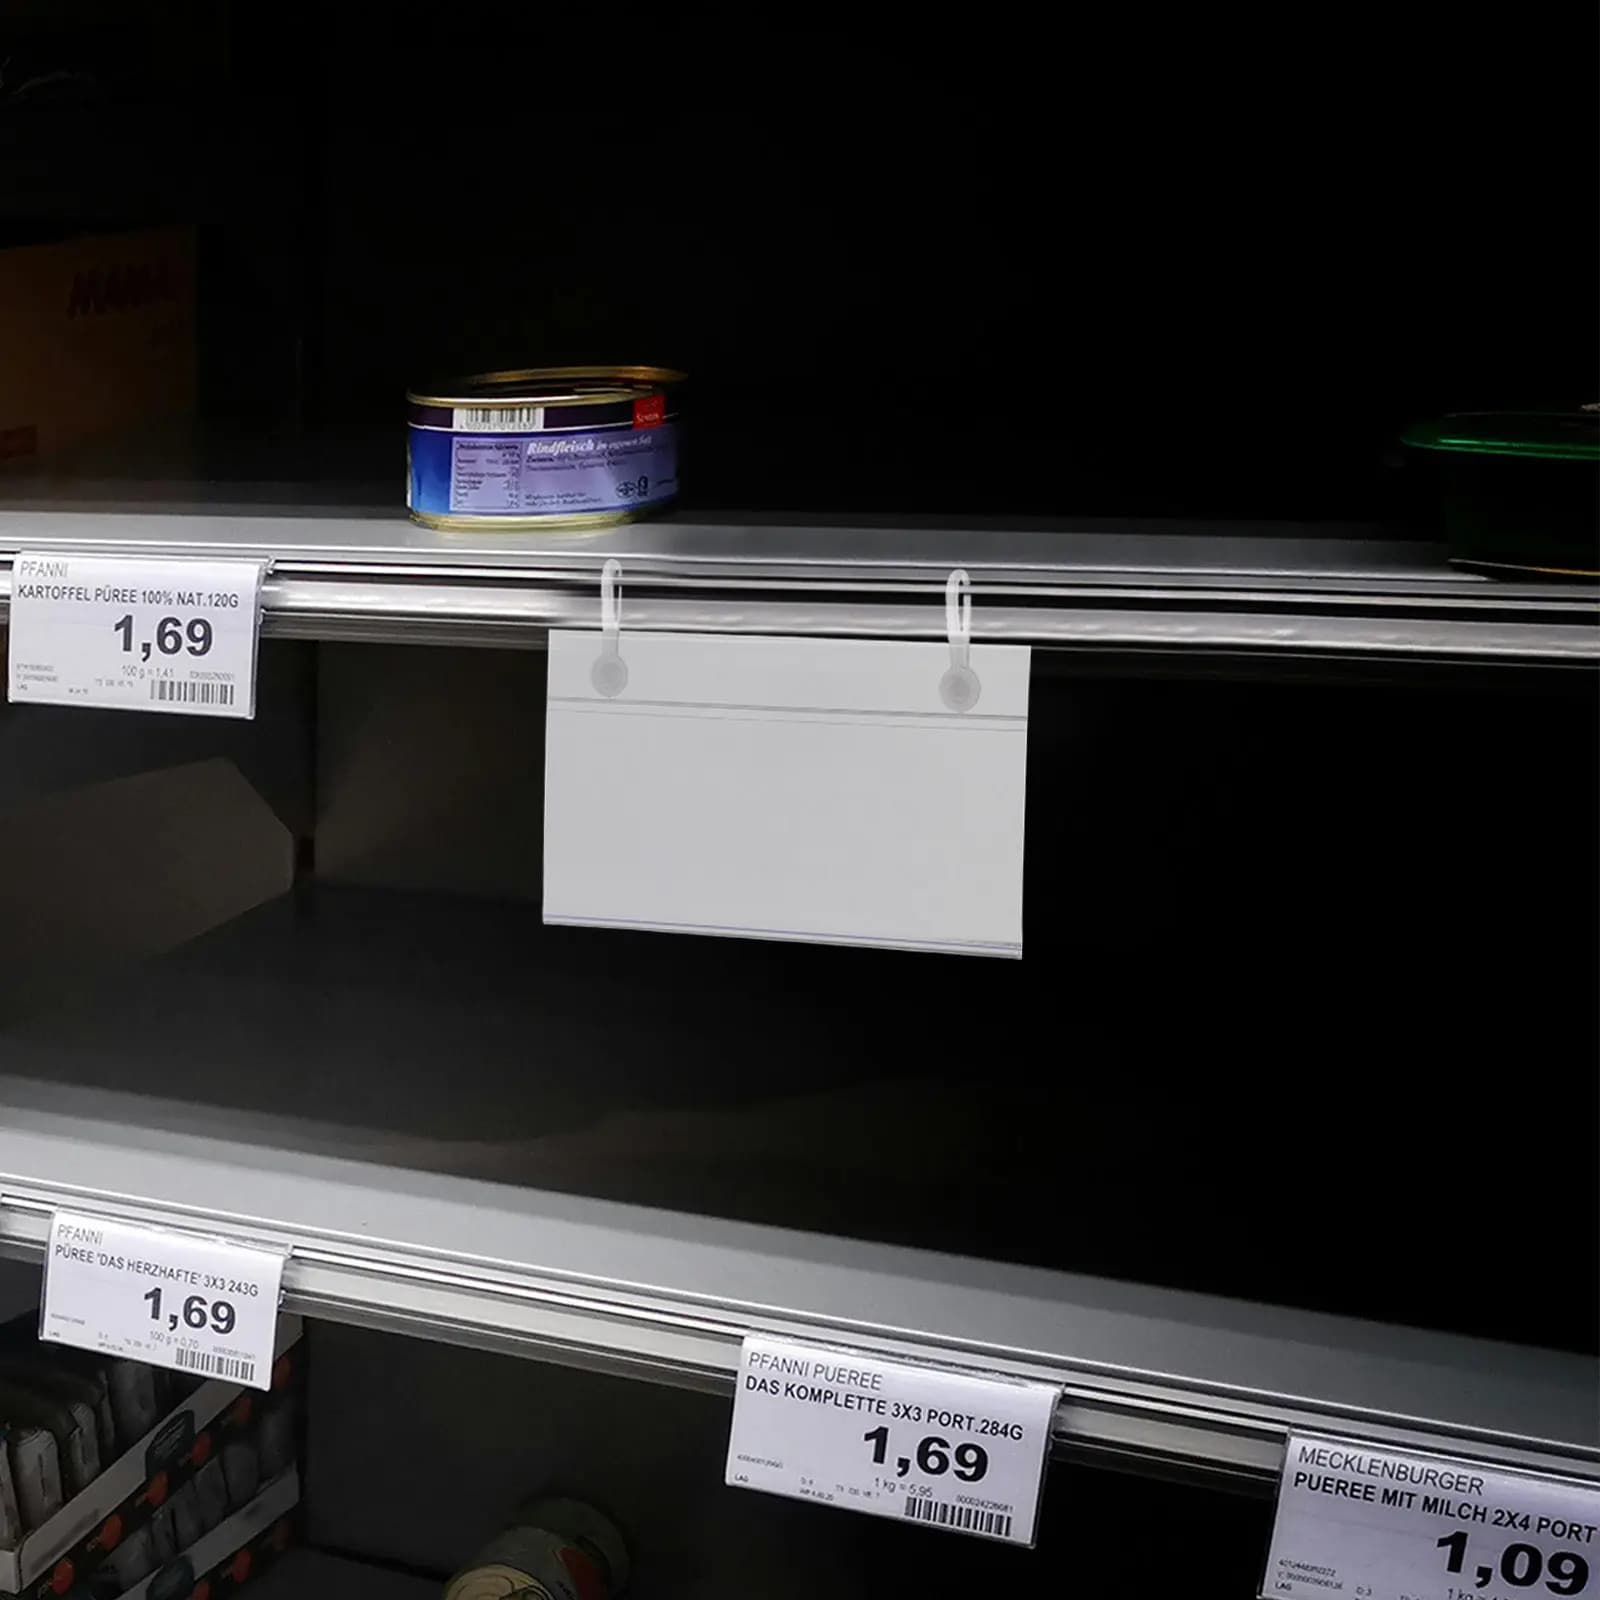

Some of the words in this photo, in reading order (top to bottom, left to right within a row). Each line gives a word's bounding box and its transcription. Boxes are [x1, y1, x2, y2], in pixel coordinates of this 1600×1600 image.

[527, 439, 594, 456] Rindfleisch
[20, 560, 69, 577] PFANNI
[18, 585, 91, 601] KARTOFFEL
[95, 585, 137, 603] PÜREE
[142, 591, 173, 606] 100%
[177, 593, 239, 608] NAT.120G
[114, 615, 213, 662] 1,69
[57, 1224, 104, 1246] PFANNI
[55, 1244, 94, 1264] PÜREE
[203, 1277, 225, 1291] 3X3
[228, 1281, 259, 1298] 243G
[144, 1287, 236, 1335] 1,69
[748, 1352, 809, 1377] PFANNI
[813, 1366, 883, 1391] PUEREE
[746, 1375, 780, 1396] DAS
[784, 1382, 887, 1415] KOMPLETTE
[891, 1402, 922, 1422] 3X3
[927, 1409, 1024, 1440] PORT.284G
[864, 1425, 988, 1483] 1,69
[1298, 1446, 1485, 1496] MECKLENBURGER
[875, 1477, 880, 1488] 1
[883, 1479, 896, 1493] kg
[1294, 1472, 1376, 1502] PUEREE
[1381, 1488, 1417, 1509] MIT
[1421, 1496, 1488, 1524] MILCH
[1492, 1509, 1531, 1531] 2X4
[1536, 1517, 1597, 1544] PORT
[1436, 1530, 1589, 1597] 1,09
